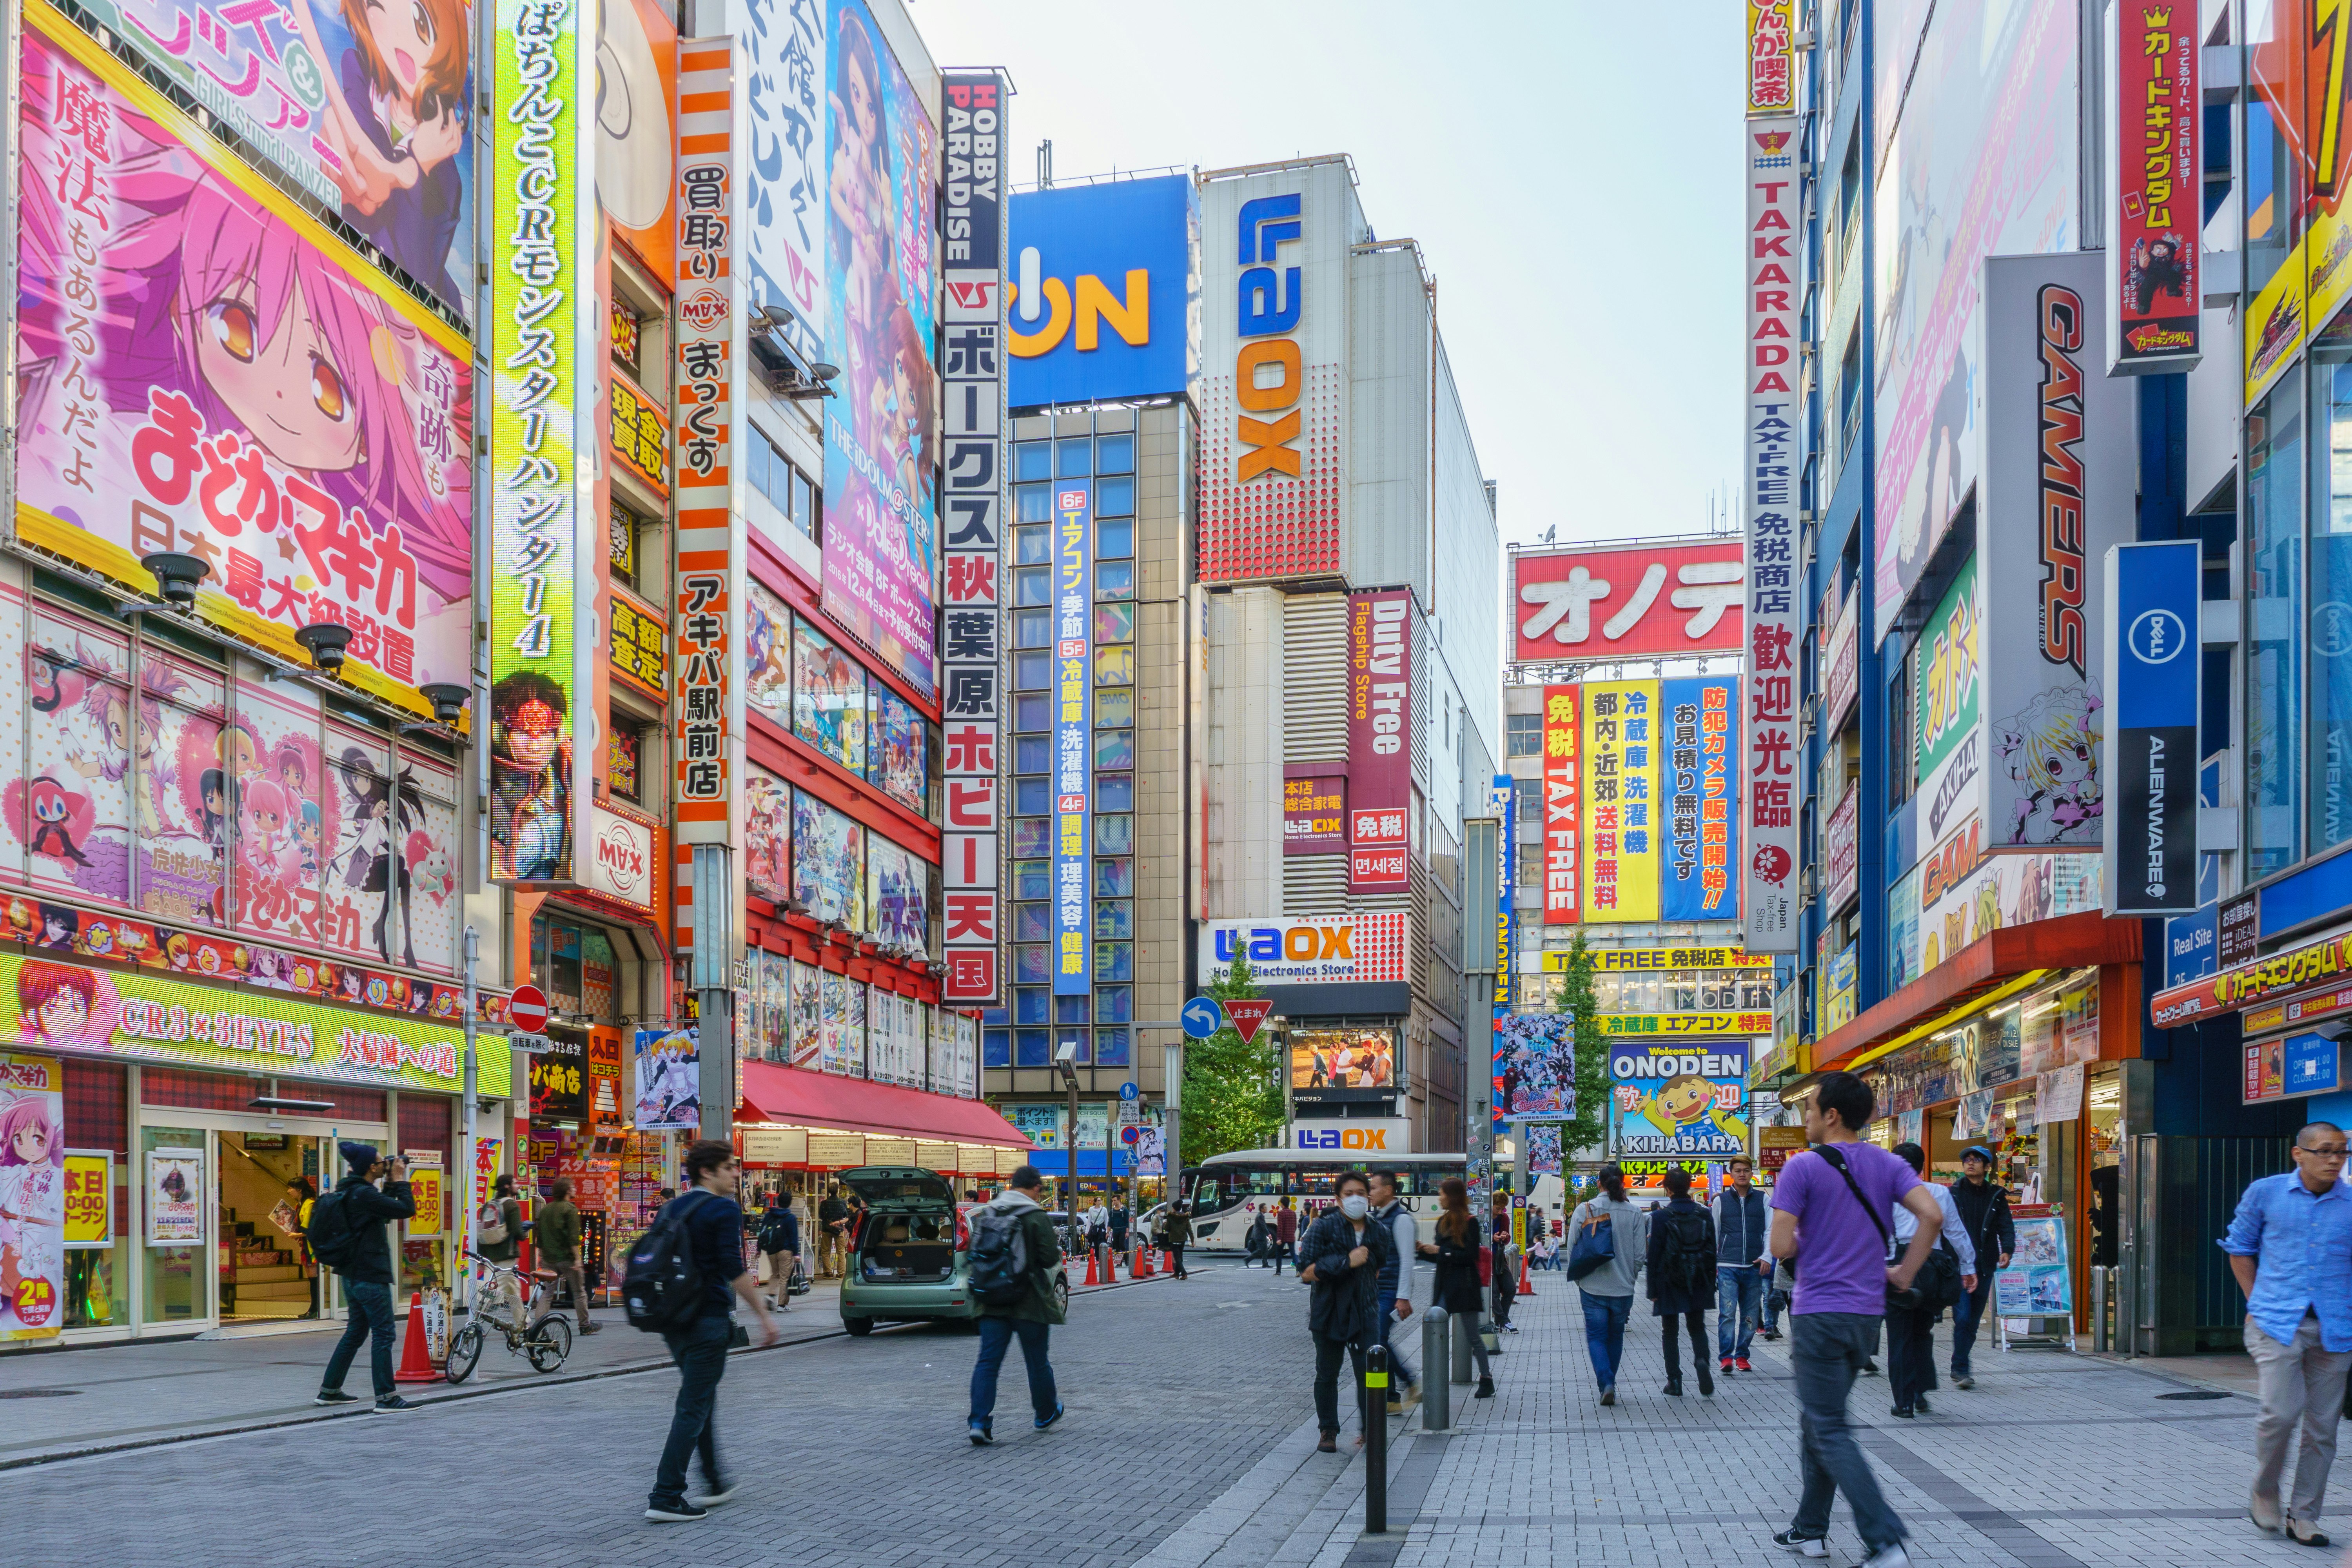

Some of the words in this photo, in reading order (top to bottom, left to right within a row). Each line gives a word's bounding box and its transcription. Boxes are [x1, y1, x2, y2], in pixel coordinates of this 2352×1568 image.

[2178, 36, 2191, 188] 余ってるカード、高く買います!
[973, 85, 996, 201] HOBBY
[1767, 134, 1779, 145] 宝
[2145, 31, 2173, 229] カードキングダム
[194, 73, 248, 136] GIRLS
[247, 118, 282, 166] und
[282, 149, 342, 214] PANZER
[947, 85, 971, 261] PARADISE
[684, 166, 724, 279] 買取り
[54, 67, 111, 493] 魔法もあるんだよ
[1752, 181, 1792, 394] TAKARADA
[2137, 331, 2194, 352] カードキングダム
[611, 381, 665, 444] 現金
[686, 342, 722, 475] まっくす
[420, 350, 453, 496] 奇跡も
[829, 411, 854, 459] THE
[611, 419, 665, 483] 買取
[1752, 404, 1792, 505] TAX-FREE
[2038, 283, 2085, 682] GAMERS
[1062, 493, 1083, 506] 6F
[1062, 512, 1083, 639] エアコン・季節
[1753, 512, 1792, 615] 免税商店
[828, 521, 874, 585] ラジオ会館
[876, 568, 889, 591] 8F
[890, 582, 932, 634] ボークスにて
[835, 599, 850, 619] VOLKS
[850, 612, 859, 626] INC.
[250, 625, 271, 639] Madoka
[272, 635, 294, 648] Partners
[612, 597, 662, 657] 高額
[1352, 602, 1370, 670] Flagship
[1370, 600, 1407, 675] Duty
[2151, 616, 2164, 657] DELL
[1062, 642, 1083, 656] 5F
[344, 665, 383, 687] ENTERTAINMENT
[611, 638, 663, 691] 査定
[686, 579, 722, 795] アキバ駅前店
[1356, 675, 1370, 720] Store
[1061, 659, 1083, 793] 冷蔵庫・洗濯機
[1373, 682, 1407, 755] Free
[1547, 695, 1574, 757] 免税
[1623, 691, 1648, 769] 冷蔵庫
[1753, 622, 1793, 828] 歓迎光臨
[1285, 780, 1313, 795] 本店
[1548, 766, 1575, 823] TAX
[1673, 704, 1698, 881] お見積り無料です
[1702, 687, 1728, 910] 防犯カメラ販売開始!!
[1061, 796, 1082, 811] 4F
[1285, 795, 1341, 812] 総合家電
[1623, 776, 1648, 855] 洗濯機
[2149, 735, 2165, 884] ALIENWARE
[1356, 815, 1402, 838] 免税
[153, 838, 173, 847] SLOT
[1355, 857, 1403, 875] 면세점
[1548, 831, 1575, 911] FREE
[152, 878, 184, 890] PUELLA
[152, 887, 207, 907] MADOKA
[1061, 814, 1083, 975] 調理・理美容・健康
[152, 899, 207, 918] MAGICA
[1756, 907, 1766, 932] Shop
[1766, 893, 1777, 932] Tax-free
[1779, 897, 1788, 932] Japan.
[2222, 902, 2256, 927] お部屋探し
[2173, 935, 2193, 956] Real
[2195, 929, 2212, 948] Site
[2235, 924, 2256, 942] iDEAL
[2235, 939, 2256, 953] アイデアル
[1252, 964, 1317, 976] Electronics
[1321, 964, 1354, 974] Store
[1494, 913, 1509, 1003] ONODEN
[1605, 953, 1665, 968] FREE
[1671, 949, 1725, 967] 免税店
[2232, 942, 2338, 1000] カードキングダム
[201, 949, 215, 970] と
[294, 966, 309, 988] あ
[372, 981, 384, 1001] り
[2270, 982, 2296, 993] Cardkingdom
[1234, 1008, 1263, 1019] 止まれ
[2156, 998, 2201, 1024] カードゲーム専門店
[2292, 1004, 2299, 1017] 6F
[2303, 995, 2336, 1013] 中古販売&買取
[1606, 1016, 1659, 1033] 冷蔵庫
[1666, 1016, 1732, 1032] エアコン
[1738, 1014, 1772, 1031] 特売
[2247, 1013, 2275, 1027] エレベーター
[512, 1037, 545, 1050] 自転車を除く
[591, 1036, 619, 1060] 入口
[1648, 1047, 1691, 1056] Welcome
[1693, 1047, 1708, 1056] to
[2003, 1040, 2008, 1048] ON
[2008, 1038, 2018, 1047] SALE
[2251, 1049, 2258, 1057] 6F
[592, 1062, 620, 1078] はコチラ
[1613, 1054, 1743, 1078] ONODEN
[2248, 1059, 2259, 1069] 鉄道
[2248, 1069, 2259, 1080] 模型
[2313, 1069, 2330, 1081] 21:00
[2248, 1080, 2258, 1090] TOY
[1017, 1107, 1056, 1116] ポイントが
[1615, 1086, 1641, 1112] 歓
[1715, 1085, 1740, 1110] 迎
[1017, 1117, 1055, 1126] 選べます!!
[1611, 1135, 1743, 1154] AKIHABARA
[64, 1171, 103, 1194] 本日
[412, 1180, 438, 1198] 本日
[18, 1280, 48, 1306] 2階
[24, 1314, 46, 1323] しようよ
